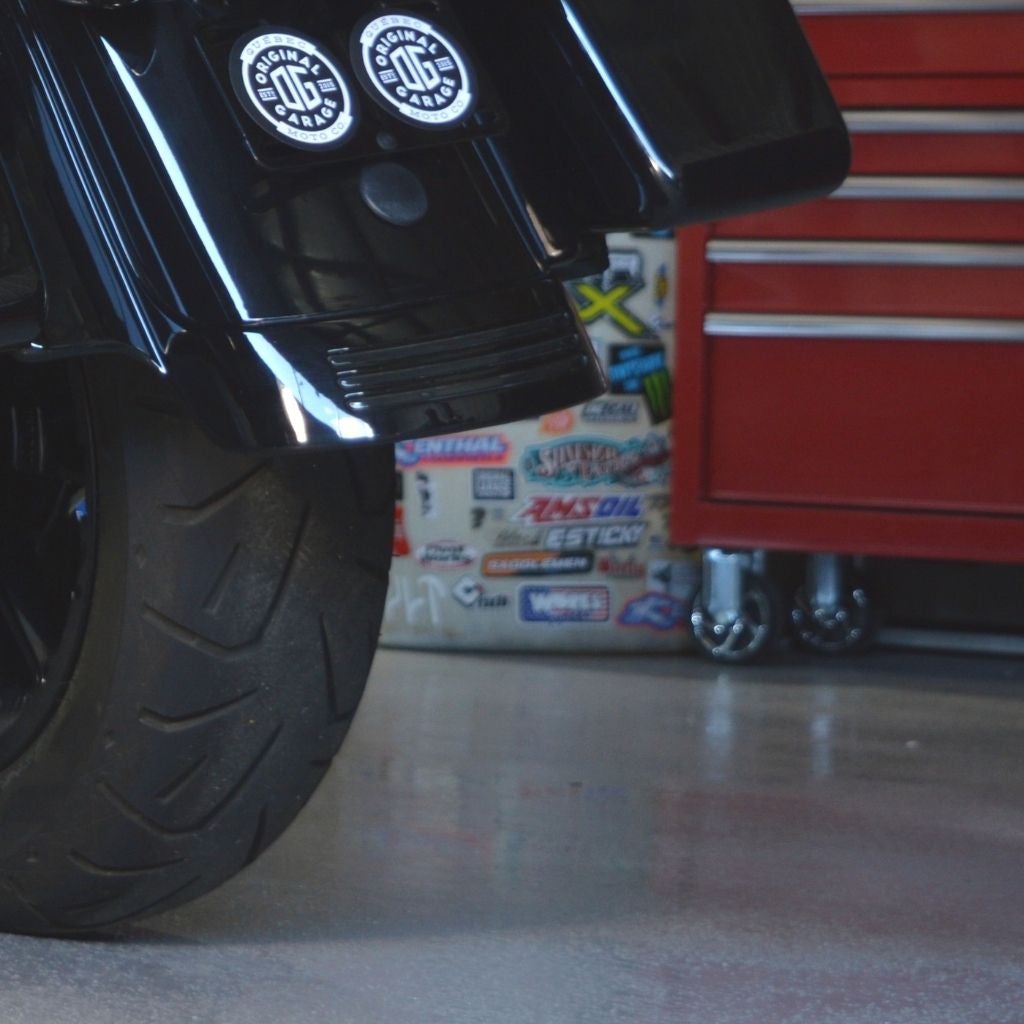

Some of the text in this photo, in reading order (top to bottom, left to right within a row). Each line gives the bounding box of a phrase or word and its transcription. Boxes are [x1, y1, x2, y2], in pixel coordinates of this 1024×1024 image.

[375, 29, 438, 66] ORIGINAL
[255, 49, 320, 84] ORIGINAL
[389, 45, 442, 91] OG
[269, 65, 322, 111] OG
[396, 76, 456, 107] GARAGE
[275, 97, 337, 127] GARAGE
[519, 496, 641, 522] AMSOIL
